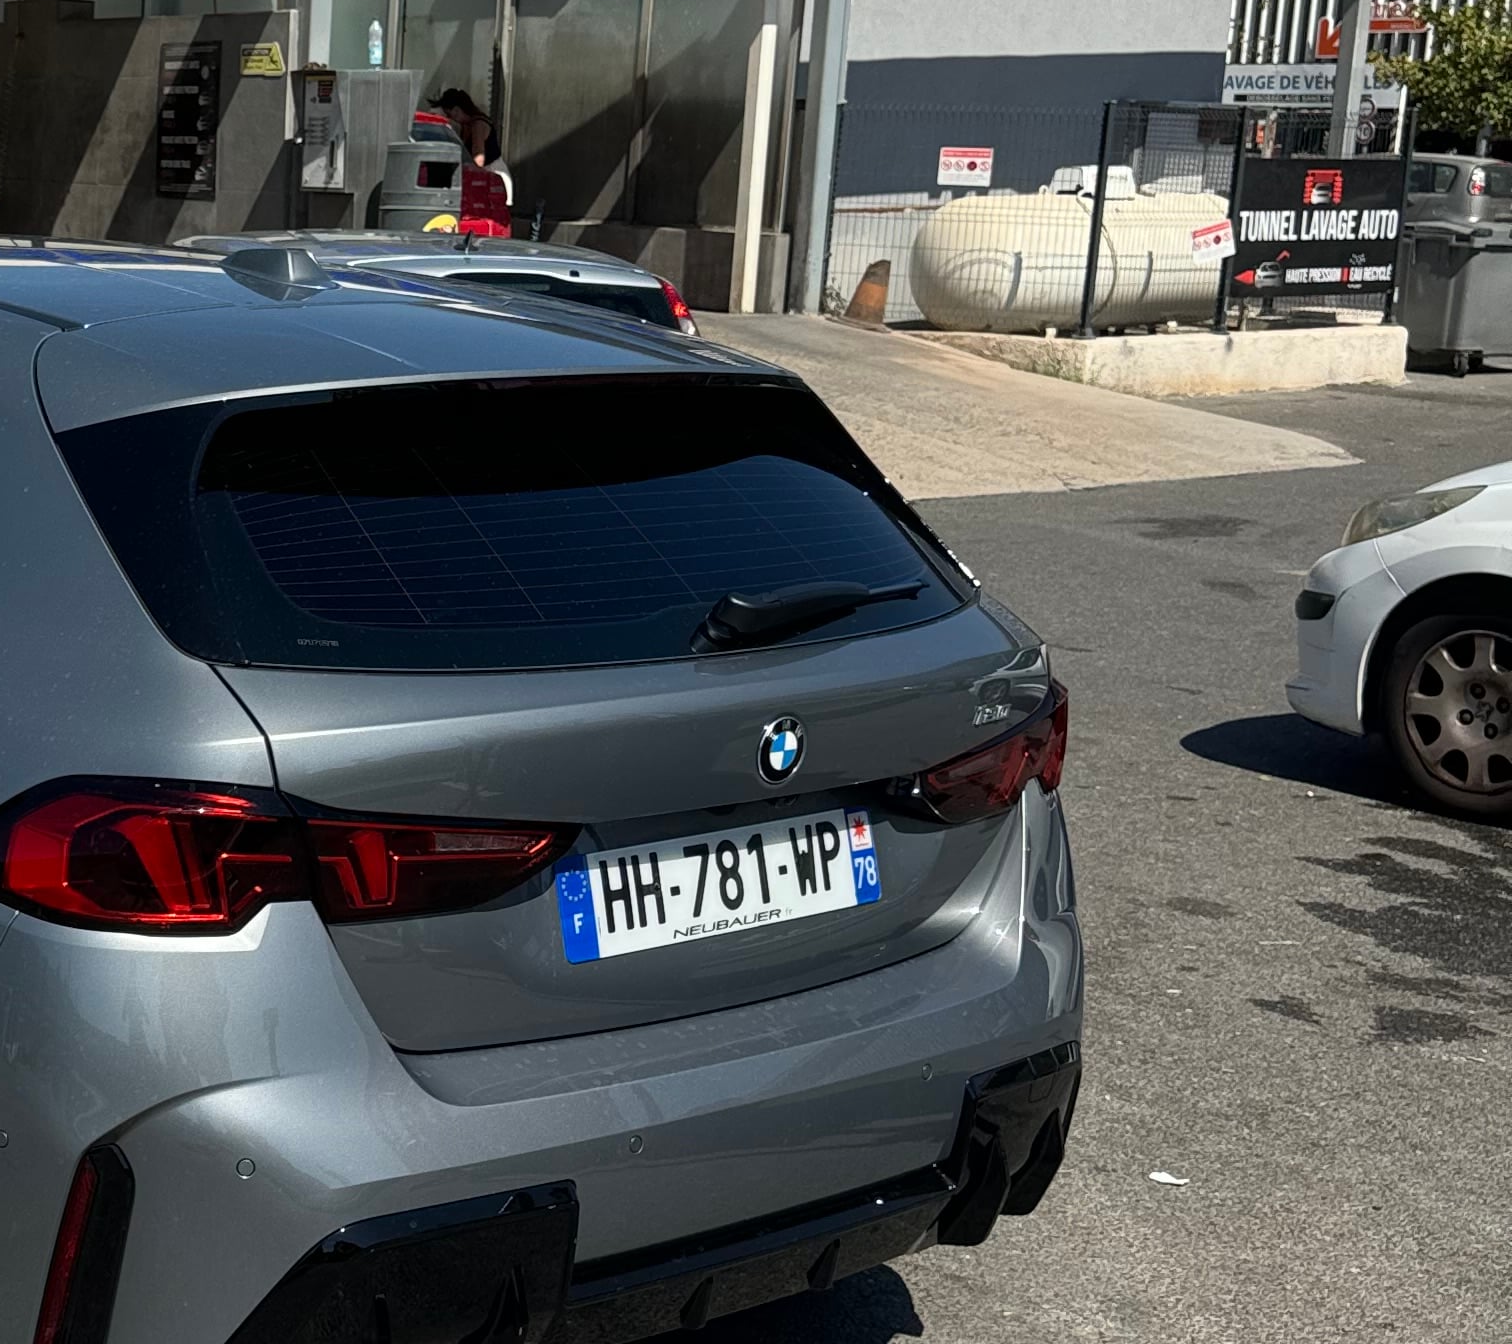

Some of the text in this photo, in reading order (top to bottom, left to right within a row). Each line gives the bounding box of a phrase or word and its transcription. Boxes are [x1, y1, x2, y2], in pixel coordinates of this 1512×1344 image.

[1224, 75, 1275, 90] AVAGE
[1279, 75, 1301, 90] DE
[1240, 210, 1298, 242] TUNNEL
[1300, 210, 1358, 241] LAVAGE
[1358, 209, 1399, 241] AUTO
[1285, 268, 1308, 283] HAUTE
[1308, 267, 1341, 283] PRESSION
[1349, 267, 1362, 282] EAU
[598, 821, 840, 934] HH-781-WP
[854, 855, 877, 889] 78
[573, 913, 584, 934] F
[673, 908, 781, 939] NEUBAUER
